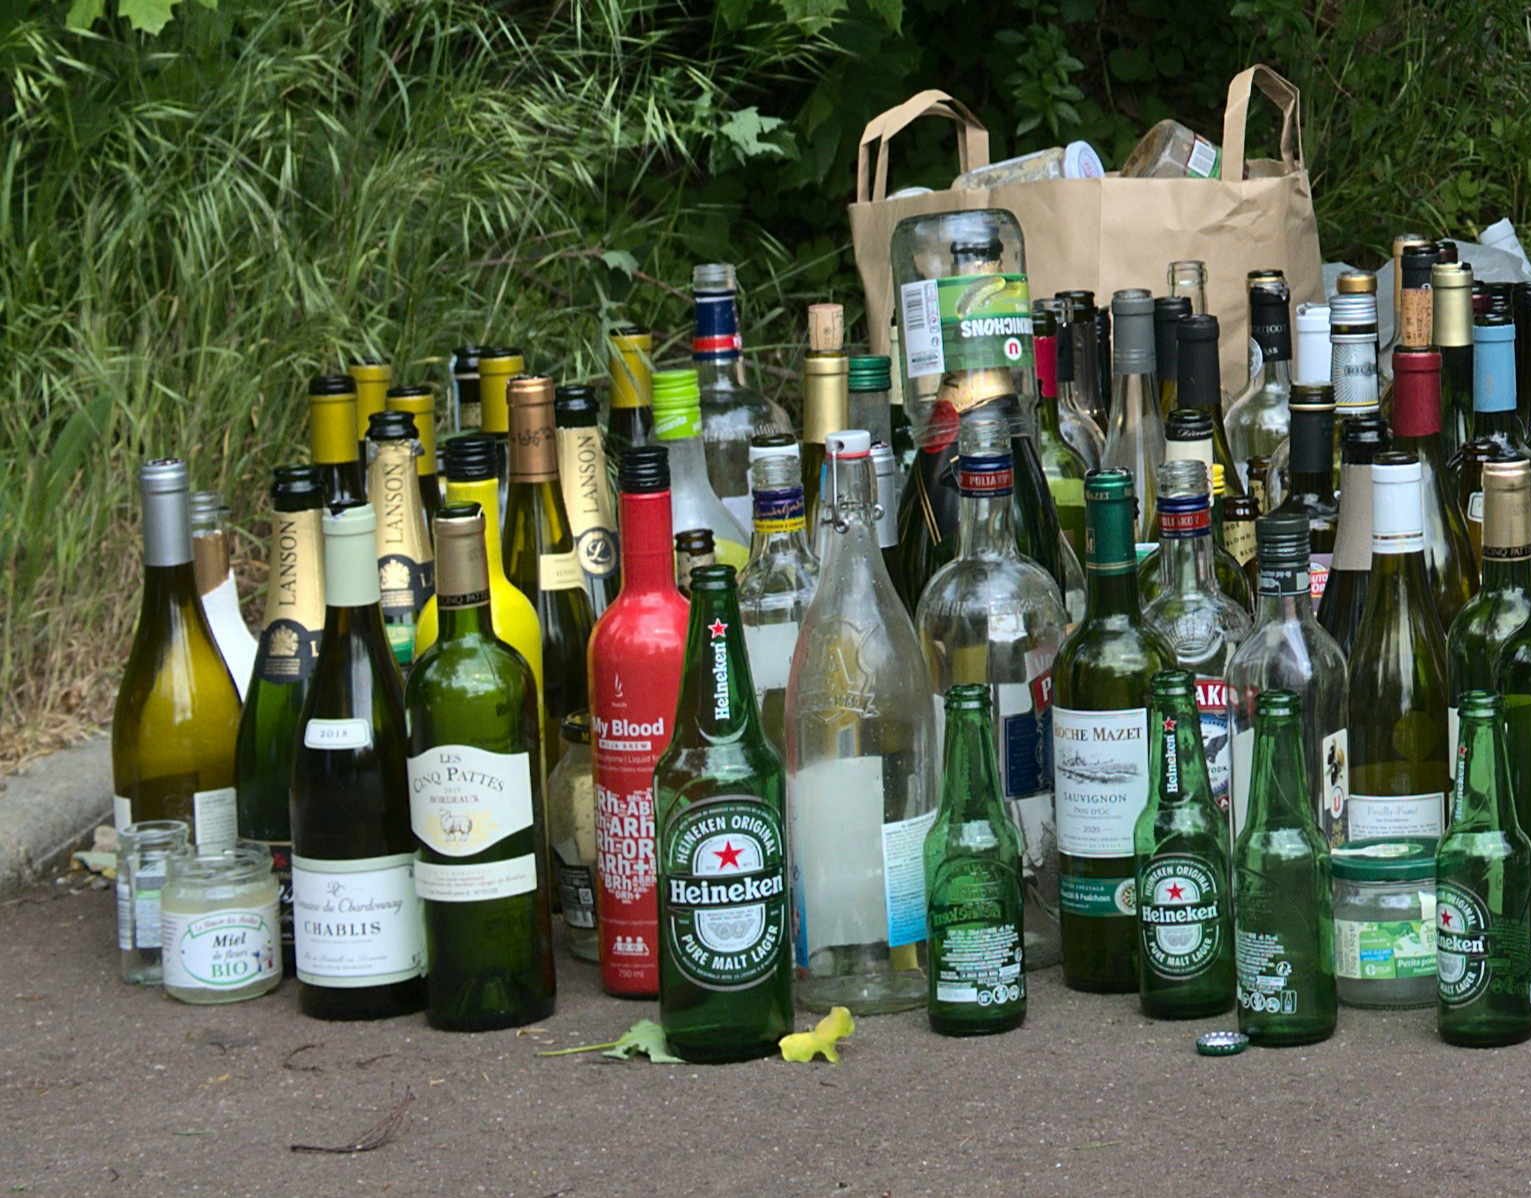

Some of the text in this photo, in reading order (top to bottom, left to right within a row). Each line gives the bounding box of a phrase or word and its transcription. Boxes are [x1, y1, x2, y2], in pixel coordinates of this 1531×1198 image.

[1348, 365, 1377, 375] RICA
[578, 435, 599, 514] LANSON
[385, 463, 404, 545] LANSON
[279, 520, 297, 606] LANSON
[710, 641, 731, 720] Heineken
[612, 717, 664, 736] Blood
[1092, 726, 1143, 742] MAZET
[440, 753, 461, 763] LES
[1165, 733, 1179, 794] Heineken
[412, 766, 505, 793] CINQ PATTES
[1063, 792, 1127, 804] SAUVIGNON
[677, 816, 726, 864] HEINEKEN
[731, 815, 777, 857] ORIGINAL
[670, 869, 784, 905] Heineken
[1176, 866, 1211, 893] ORIGINAL
[338, 898, 404, 916] Chardonnay
[1142, 903, 1218, 923] Heineken
[212, 932, 247, 948] Miel
[304, 920, 381, 937] CHABLIS
[681, 933, 711, 966] PURE
[712, 954, 748, 971] MALT
[751, 924, 779, 964] LAGER
[1166, 955, 1190, 966] MALT
[1192, 937, 1213, 963] LAGER
[1437, 935, 1486, 953] ineken
[211, 961, 248, 978] BIO
